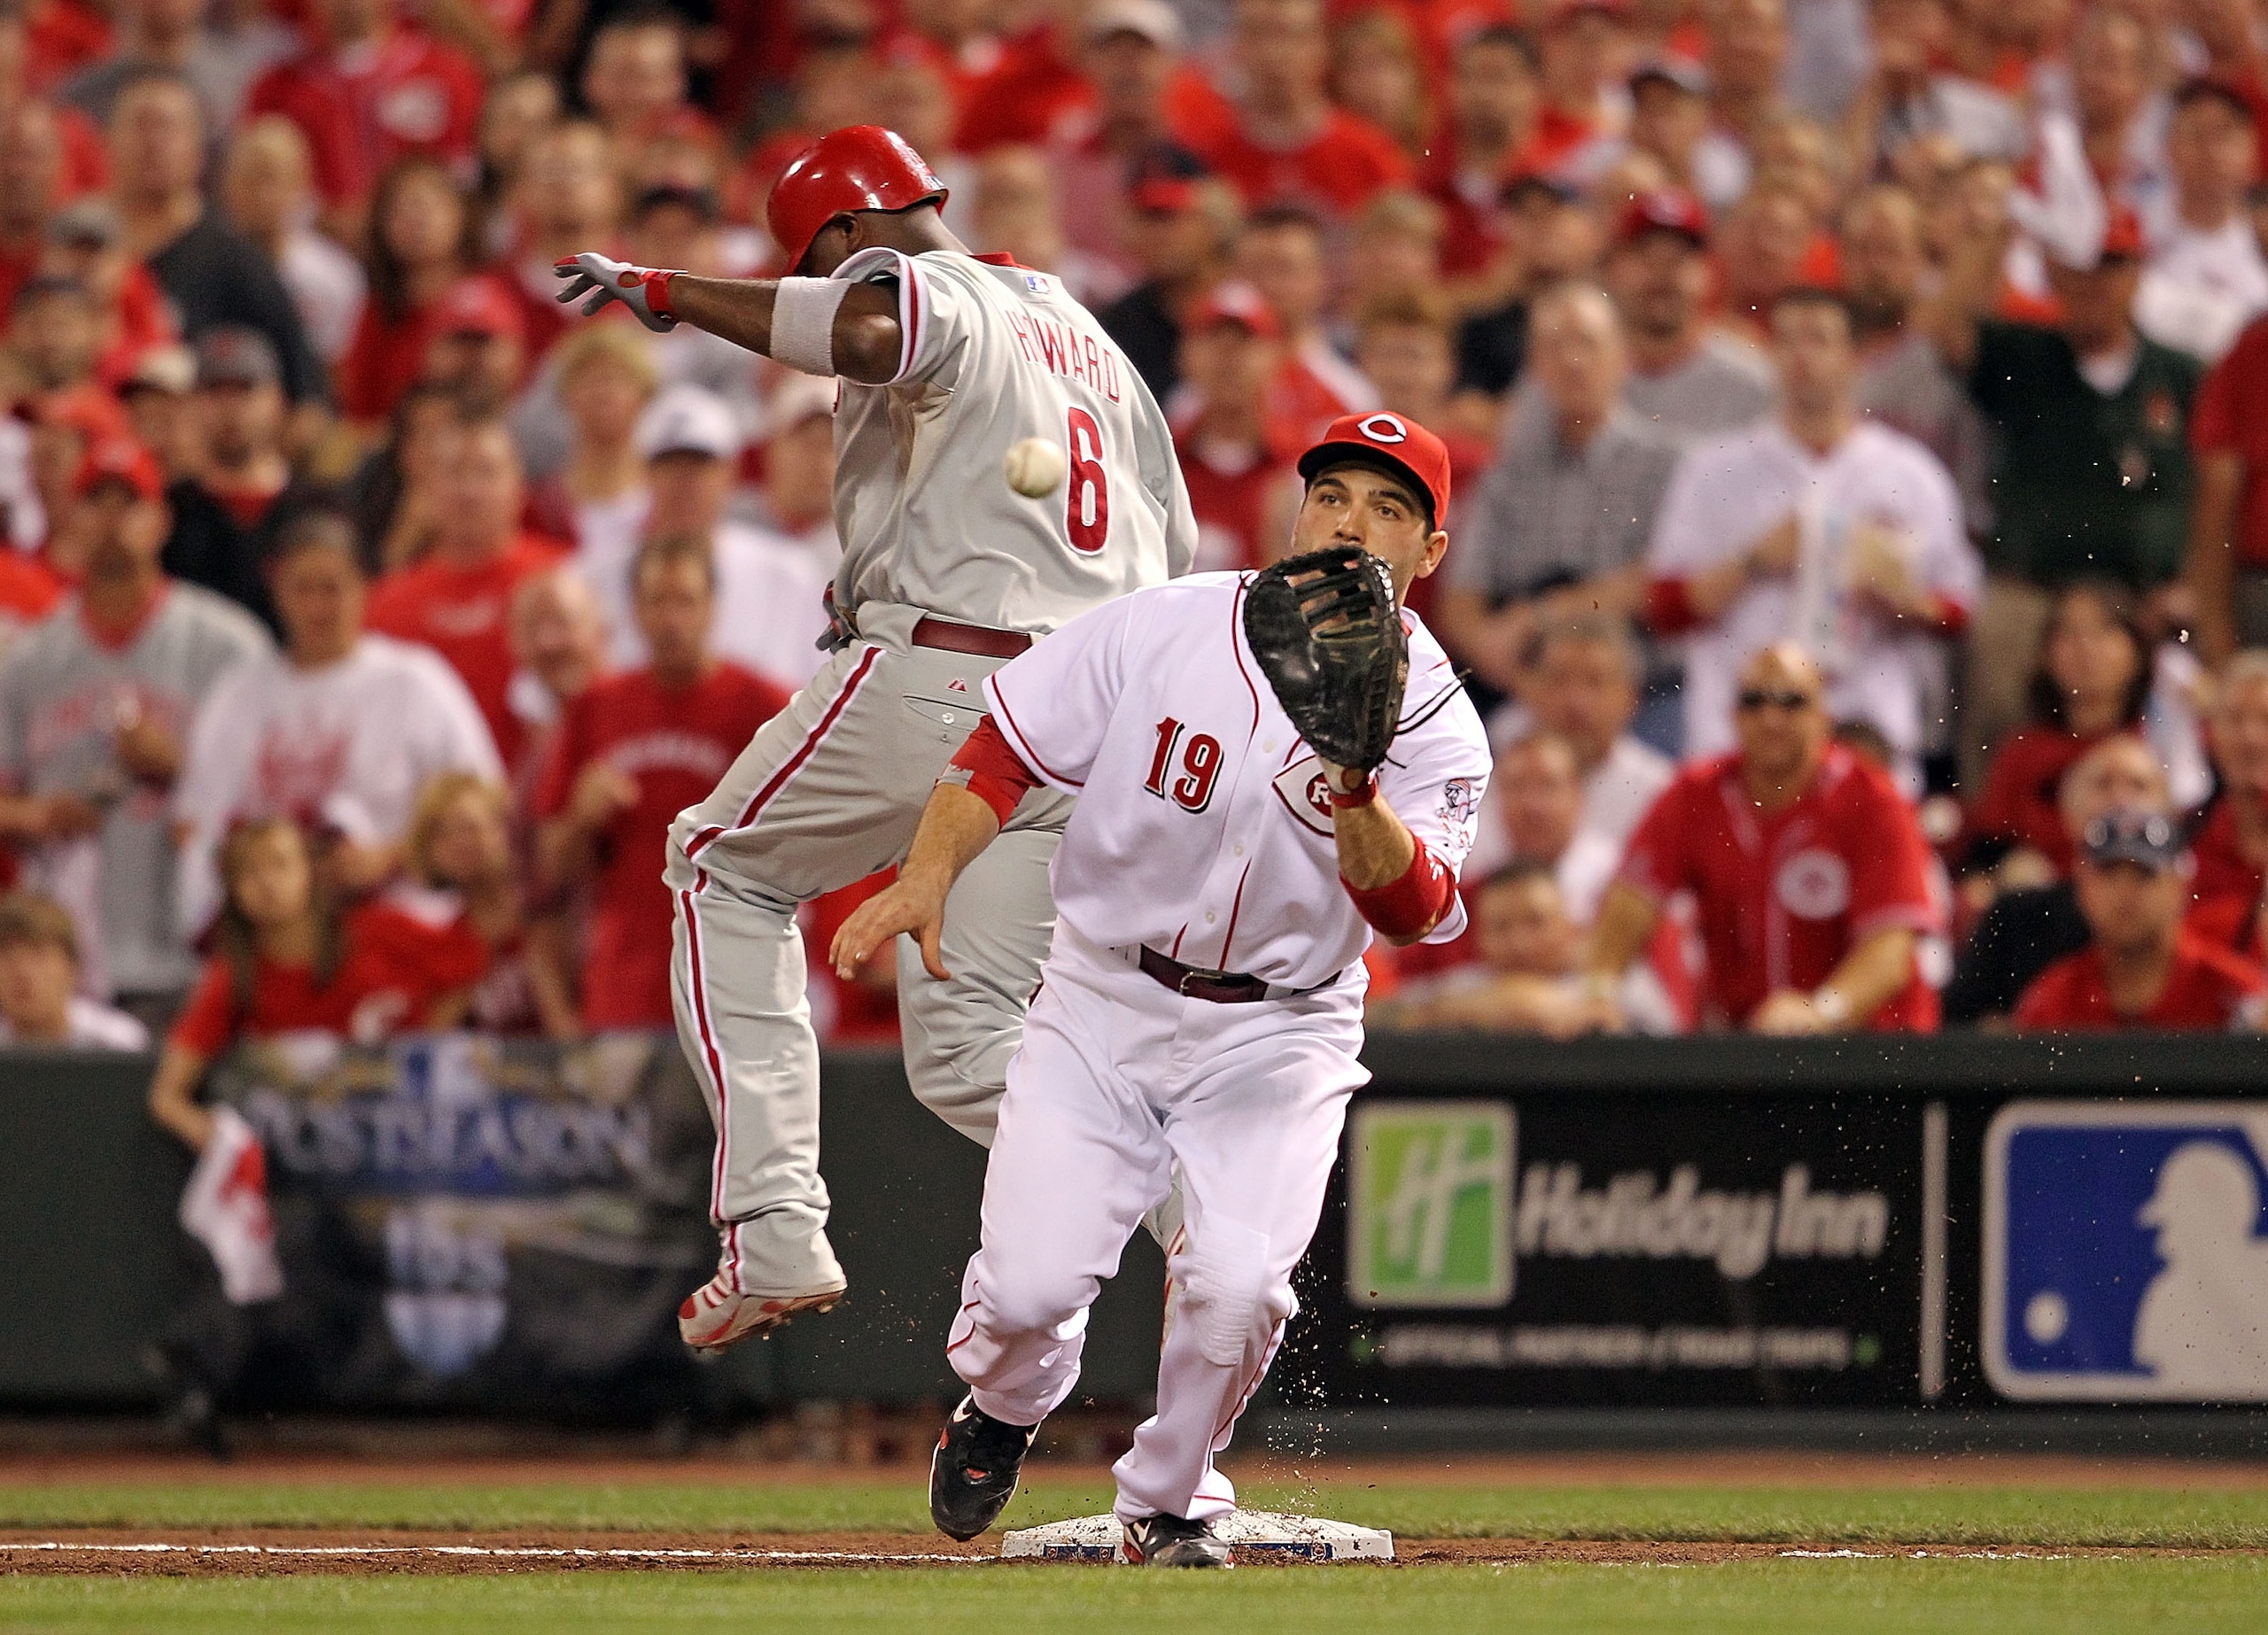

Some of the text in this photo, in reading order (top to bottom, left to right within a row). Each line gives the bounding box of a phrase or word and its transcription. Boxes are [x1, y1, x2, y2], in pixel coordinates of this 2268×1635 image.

[1066, 405, 1109, 554] 6
[1357, 414, 1407, 443] C
[1144, 717, 1224, 815] 19
[1518, 1164, 1887, 1277] Holiday Inn
